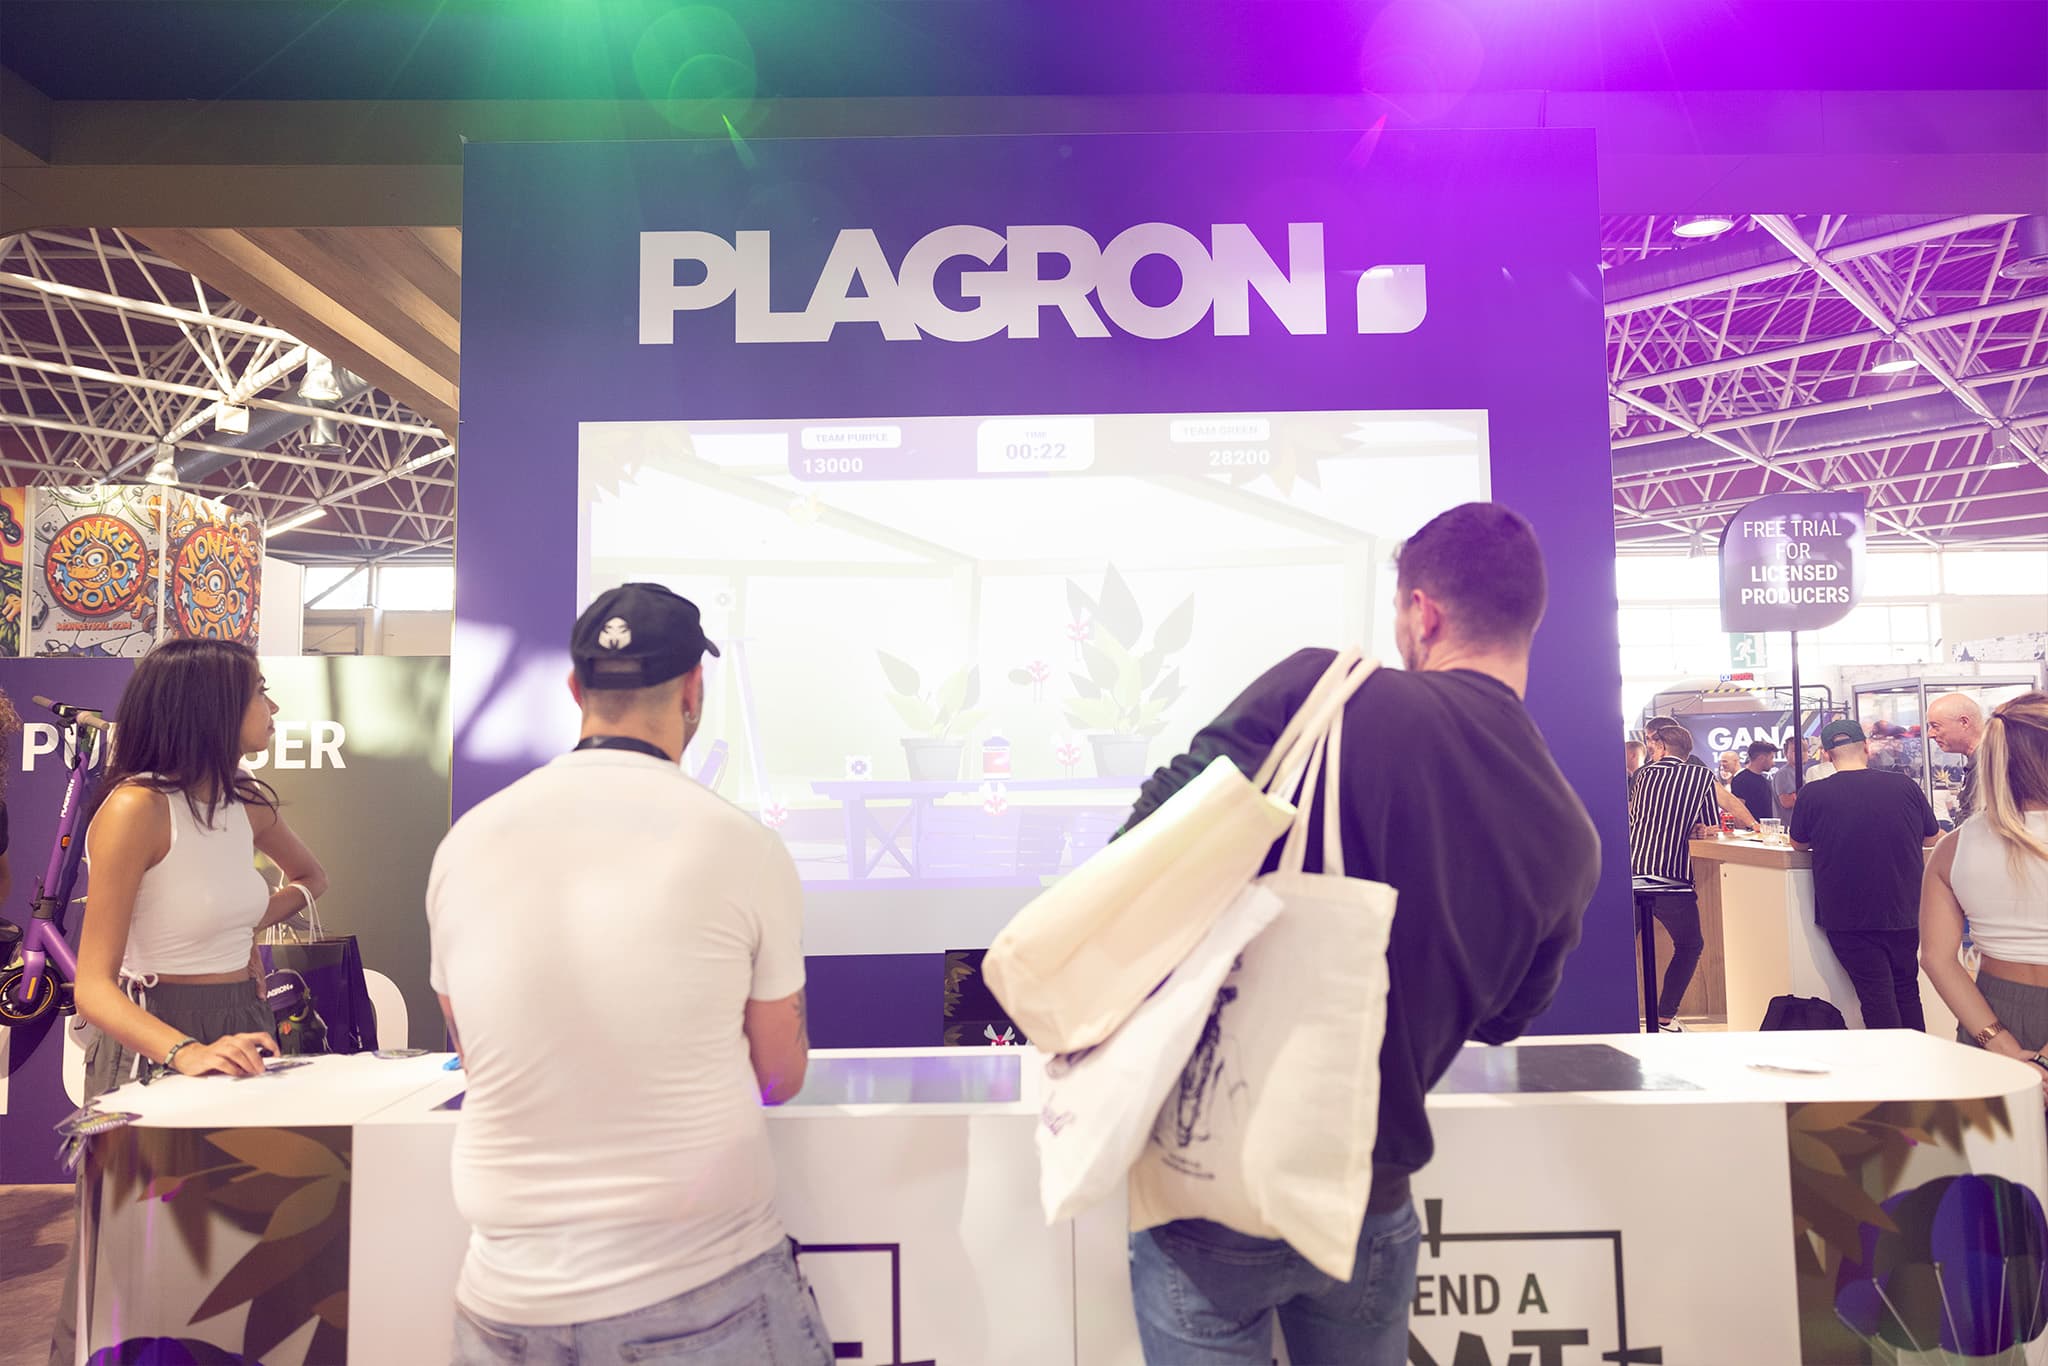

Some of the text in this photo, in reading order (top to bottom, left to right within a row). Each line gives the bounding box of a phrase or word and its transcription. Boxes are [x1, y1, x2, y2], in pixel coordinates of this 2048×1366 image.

[638, 221, 1328, 344] PLAGRON
[815, 431, 888, 443] TEAM PURPLE
[1005, 442, 1067, 460] 00:22
[1209, 449, 1270, 466] 28200
[803, 457, 864, 474] 13000
[1743, 519, 1842, 538] FREE TRIAL
[52, 520, 141, 564] MONKEY
[1776, 542, 1812, 560] FOR
[179, 531, 251, 594] MONKEY
[1751, 564, 1838, 583] LICENSED
[63, 581, 131, 609] SOIL
[1741, 586, 1850, 605] PRODUCERS
[187, 607, 242, 640] SOIL
[1413, 1272, 1549, 1317] END A
